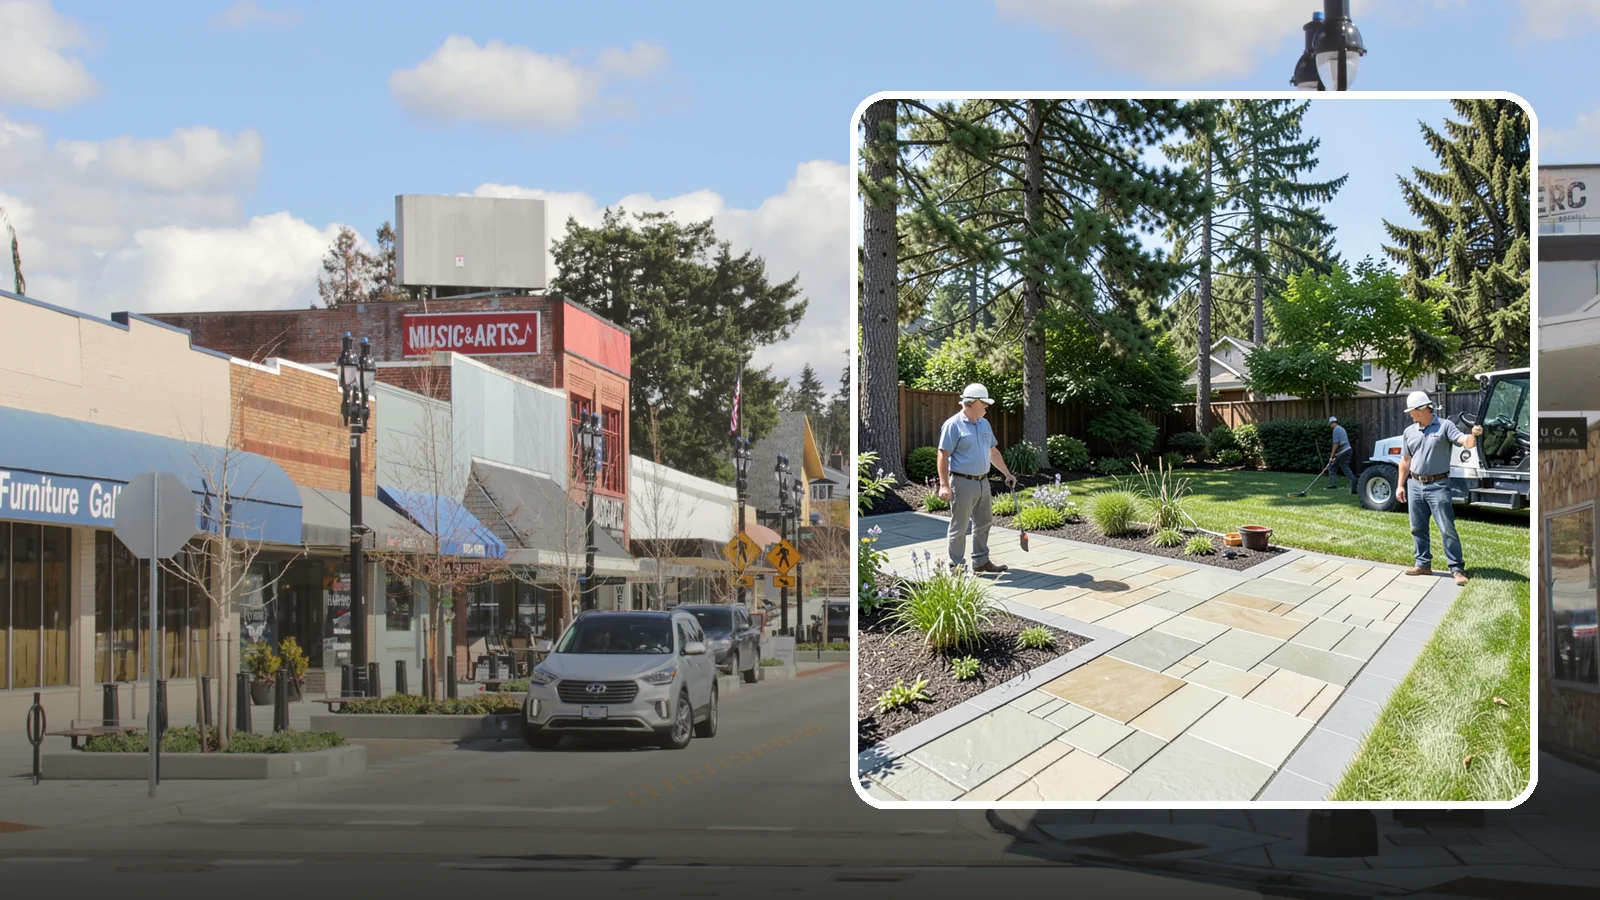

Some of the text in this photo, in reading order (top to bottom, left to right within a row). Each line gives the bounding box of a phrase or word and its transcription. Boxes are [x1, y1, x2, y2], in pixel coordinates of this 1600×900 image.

[408, 323, 520, 348] MUSIC&ARTS
[1540, 427, 1577, 436] UGA
[0, 471, 121, 518] Furniture Gal
[453, 563, 478, 573] SUSHI
